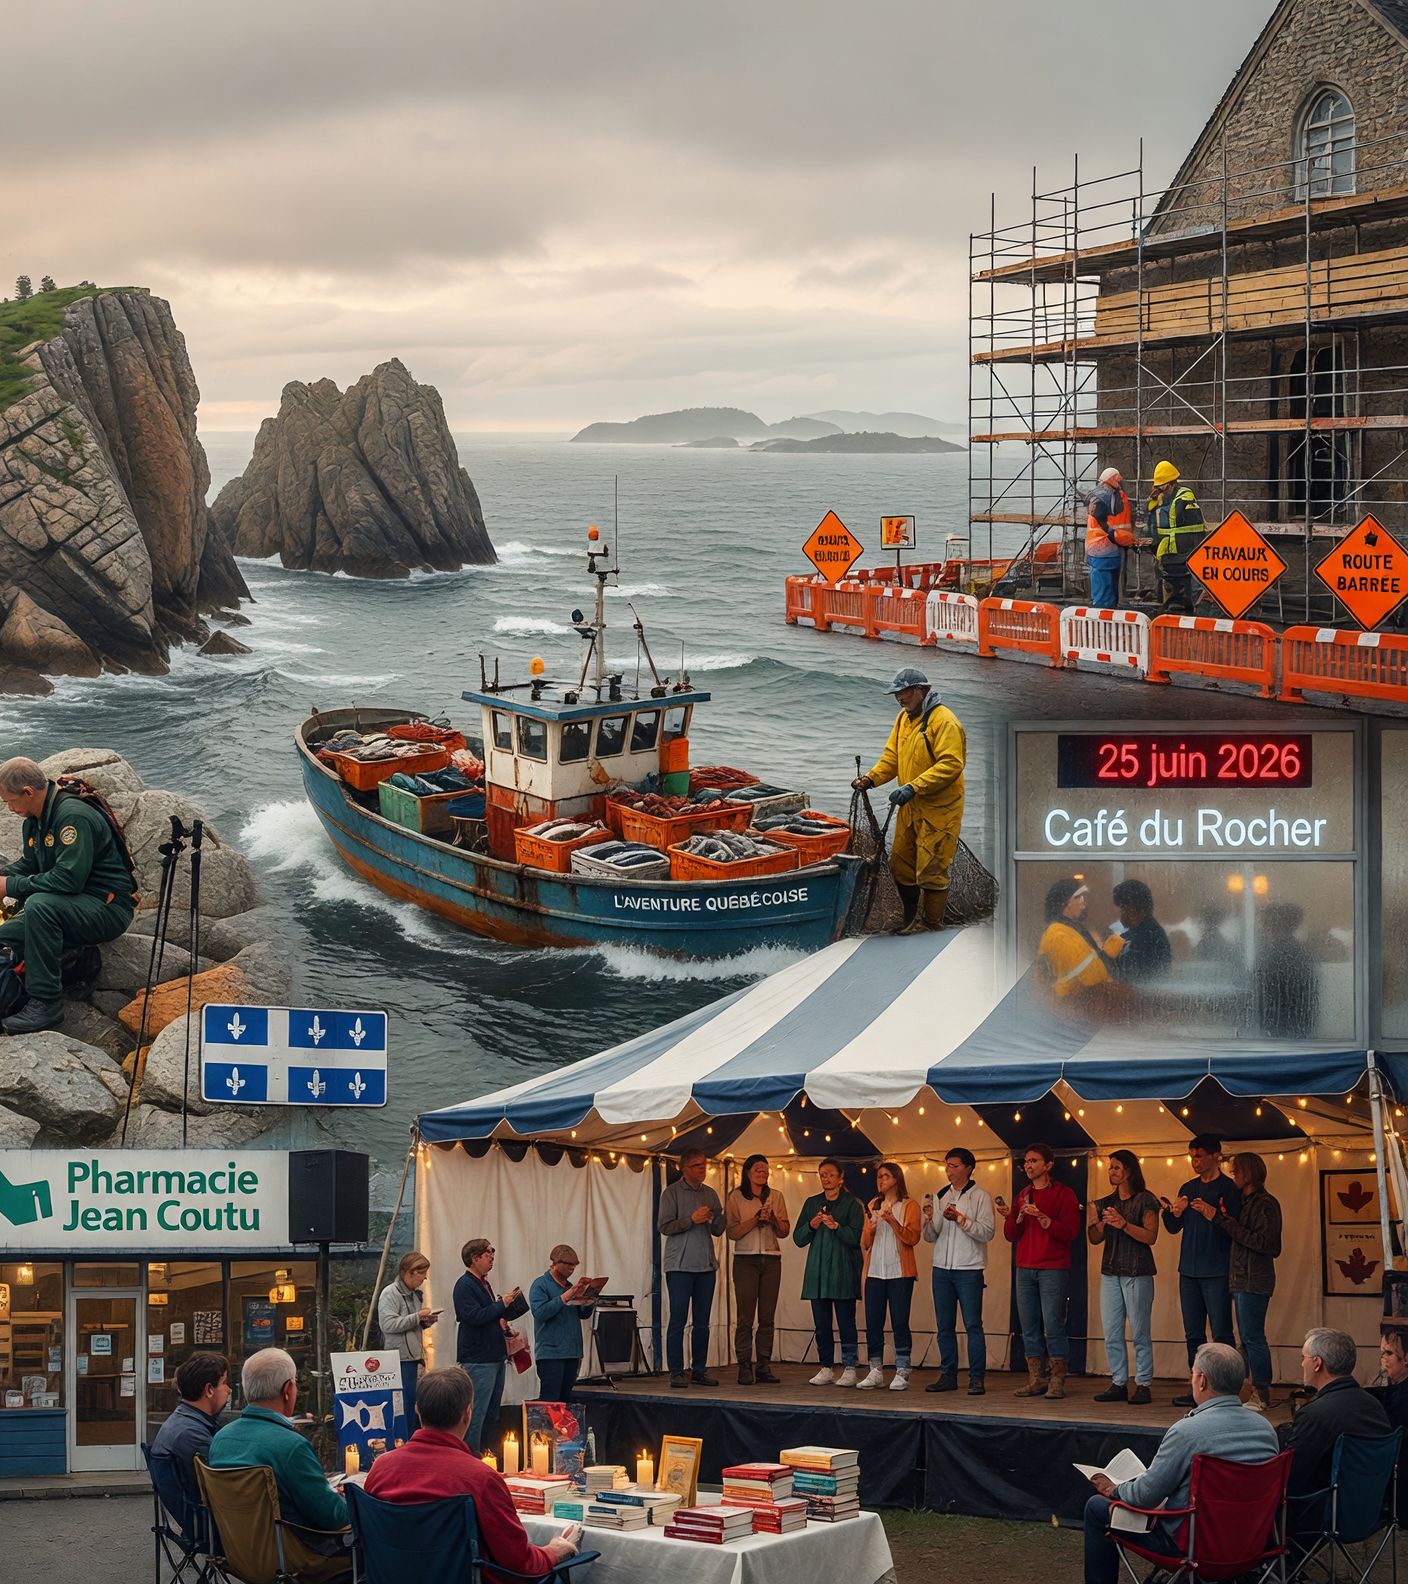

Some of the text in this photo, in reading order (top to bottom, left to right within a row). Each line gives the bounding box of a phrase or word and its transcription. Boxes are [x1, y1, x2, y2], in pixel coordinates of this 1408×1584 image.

[1202, 566, 1219, 580] EN
[1342, 554, 1393, 570] ROUTE
[1098, 743, 1300, 787] 25 juin 2026
[1044, 809, 1327, 846] Café du Rocher
[614, 895, 701, 911] L'AVENTURE
[67, 1159, 259, 1194] Pharmacie
[62, 1200, 260, 1231] Jean Coutu
